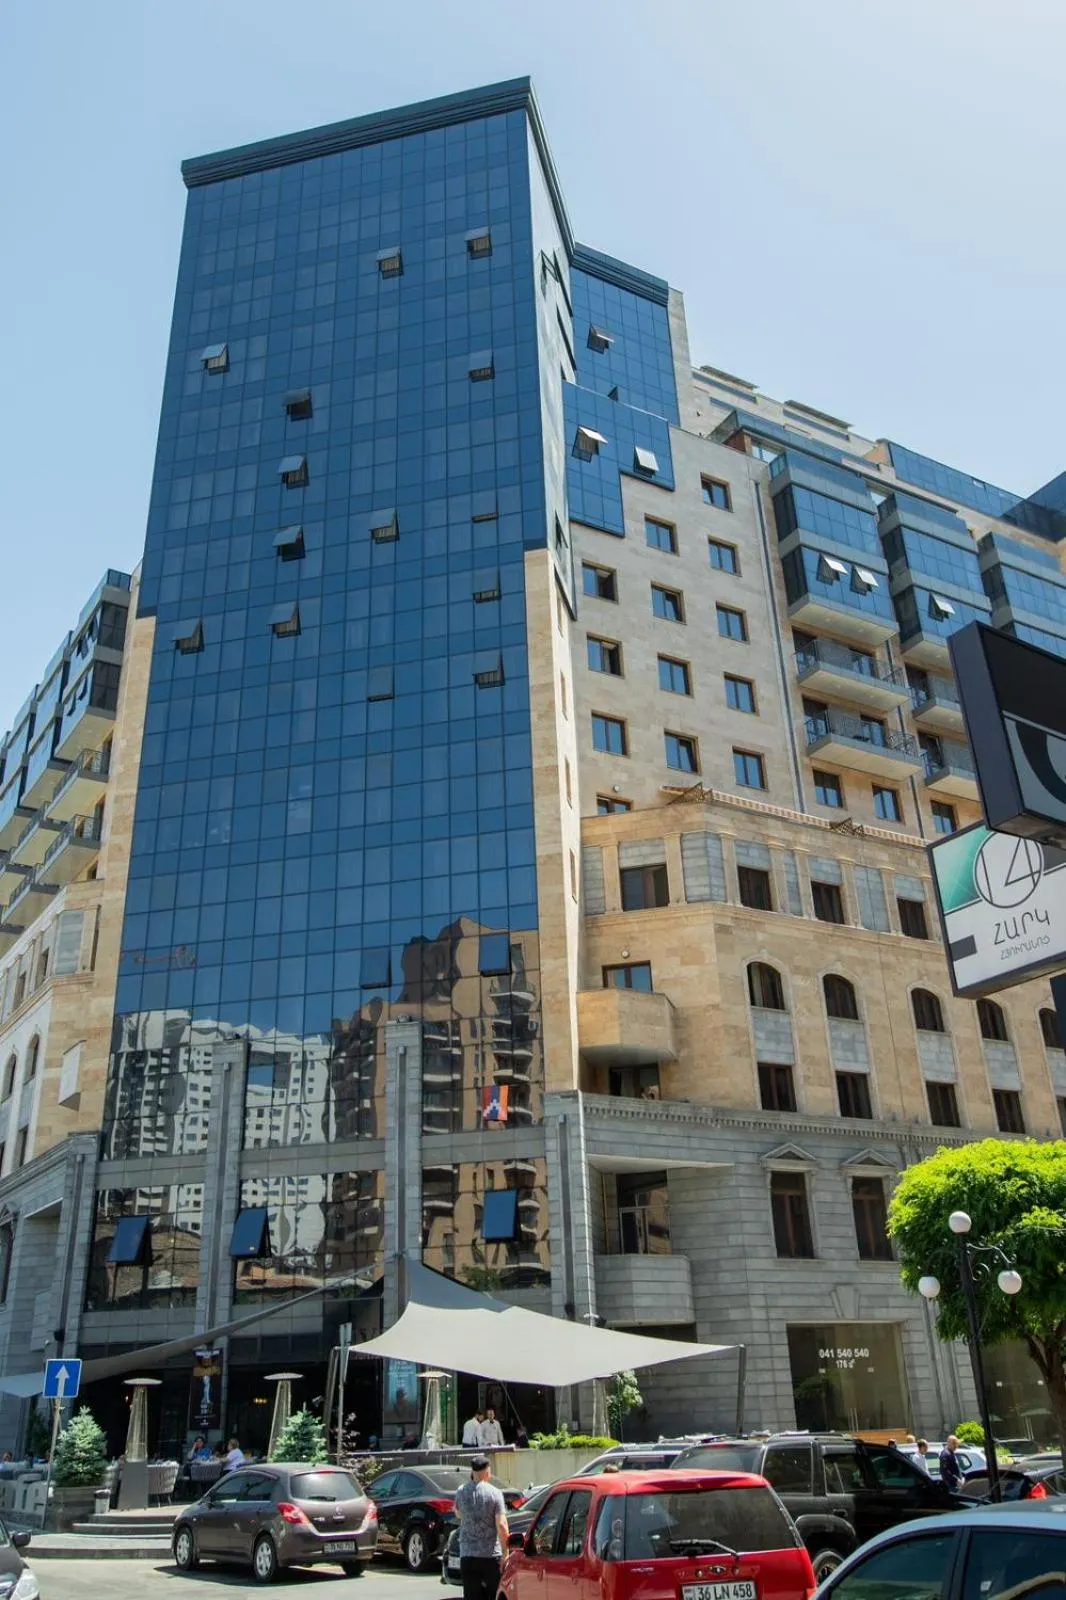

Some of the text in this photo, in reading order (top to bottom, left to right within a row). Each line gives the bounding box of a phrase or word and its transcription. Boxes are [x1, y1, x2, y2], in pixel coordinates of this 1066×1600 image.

[819, 1347, 870, 1359] 041 540 540
[697, 1583, 753, 1600] 36 LN 458
